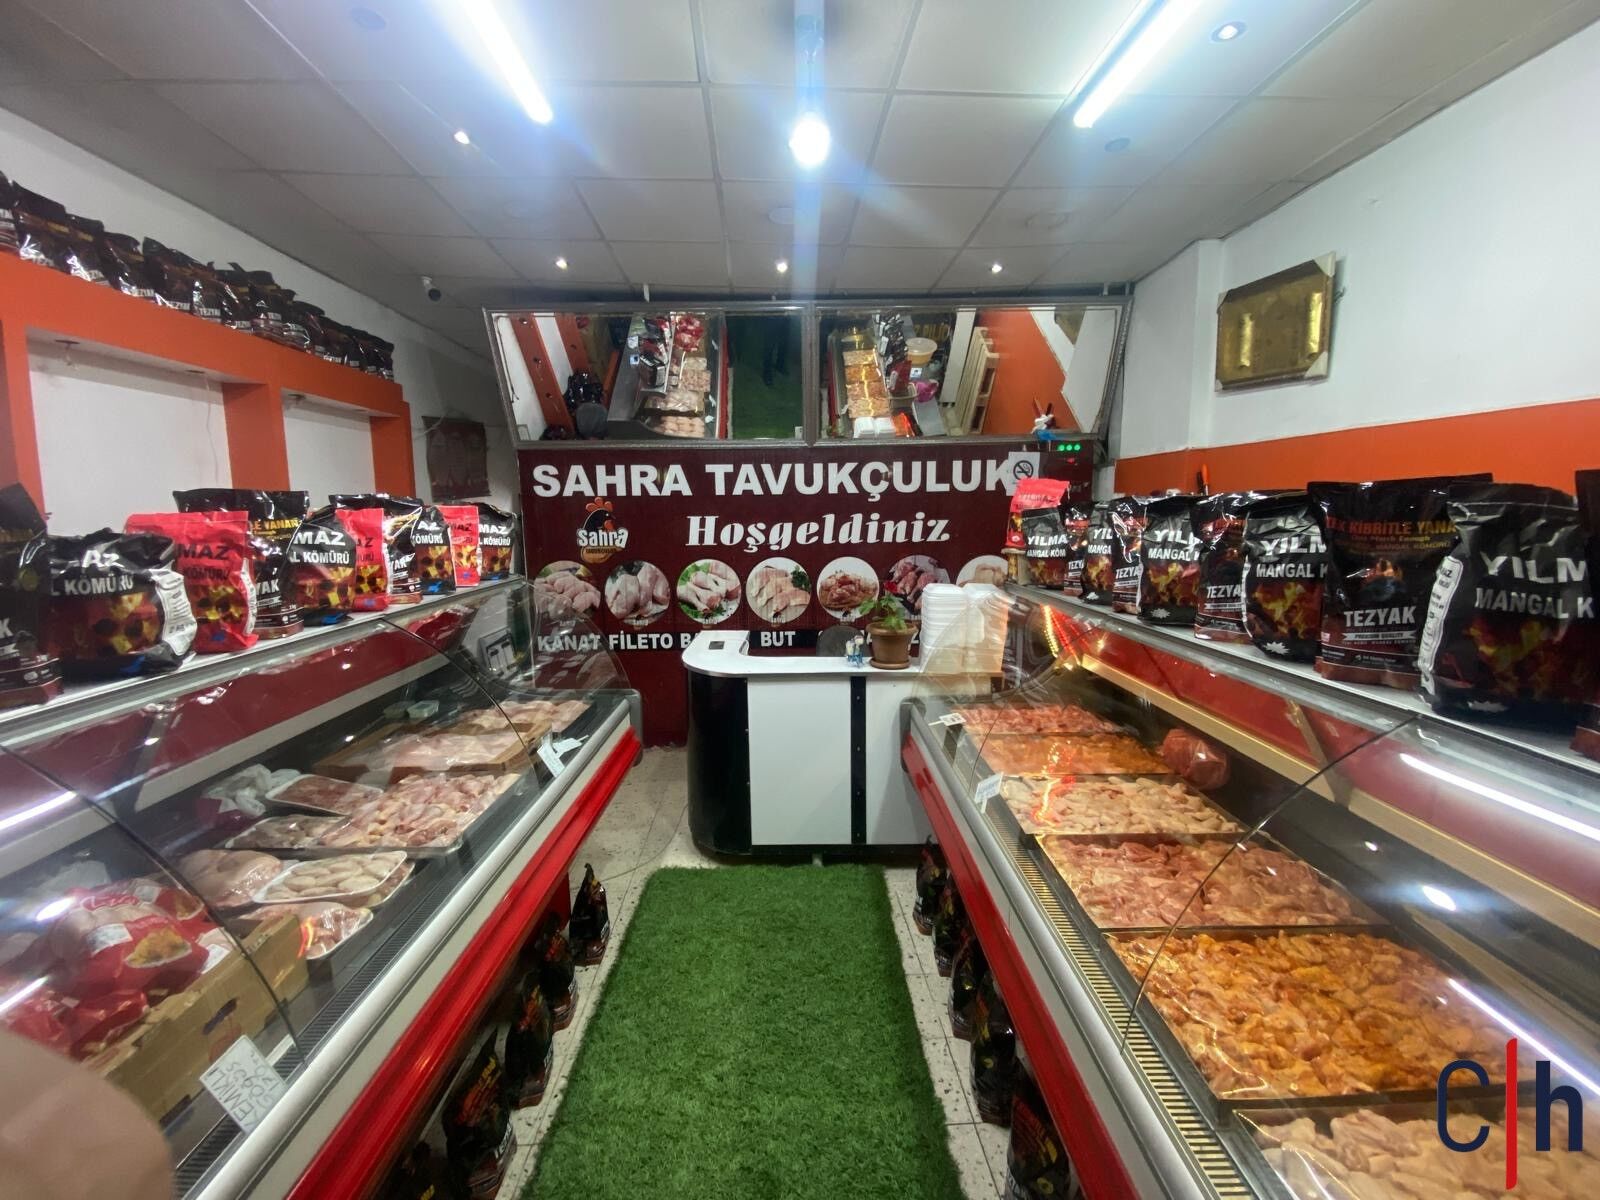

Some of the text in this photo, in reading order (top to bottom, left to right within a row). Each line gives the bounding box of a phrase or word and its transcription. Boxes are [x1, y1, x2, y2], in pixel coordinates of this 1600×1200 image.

[533, 459, 1010, 502] SAHRA TAVUKÇULUK
[479, 523, 509, 535] MAZ
[686, 512, 951, 553] Hoşgeldiniz
[1093, 527, 1113, 540] YIL
[1416, 520, 1457, 534] YANA
[292, 530, 346, 546] MAZ
[576, 527, 629, 549] Sahra
[1027, 533, 1069, 546] YILMA
[176, 543, 230, 560] MAZ
[302, 550, 350, 565] KÖMÜRÜ
[1148, 548, 1191, 562] MANGAL
[1115, 566, 1141, 579] TEZYA
[1256, 563, 1315, 578] MANGAL
[1206, 583, 1242, 599] TEZYA
[1474, 587, 1569, 619] MANGAL
[1343, 606, 1417, 628] TEZYAK
[537, 633, 601, 652] KANAT
[608, 630, 674, 650] FİLETO
[760, 631, 796, 647] BUT
